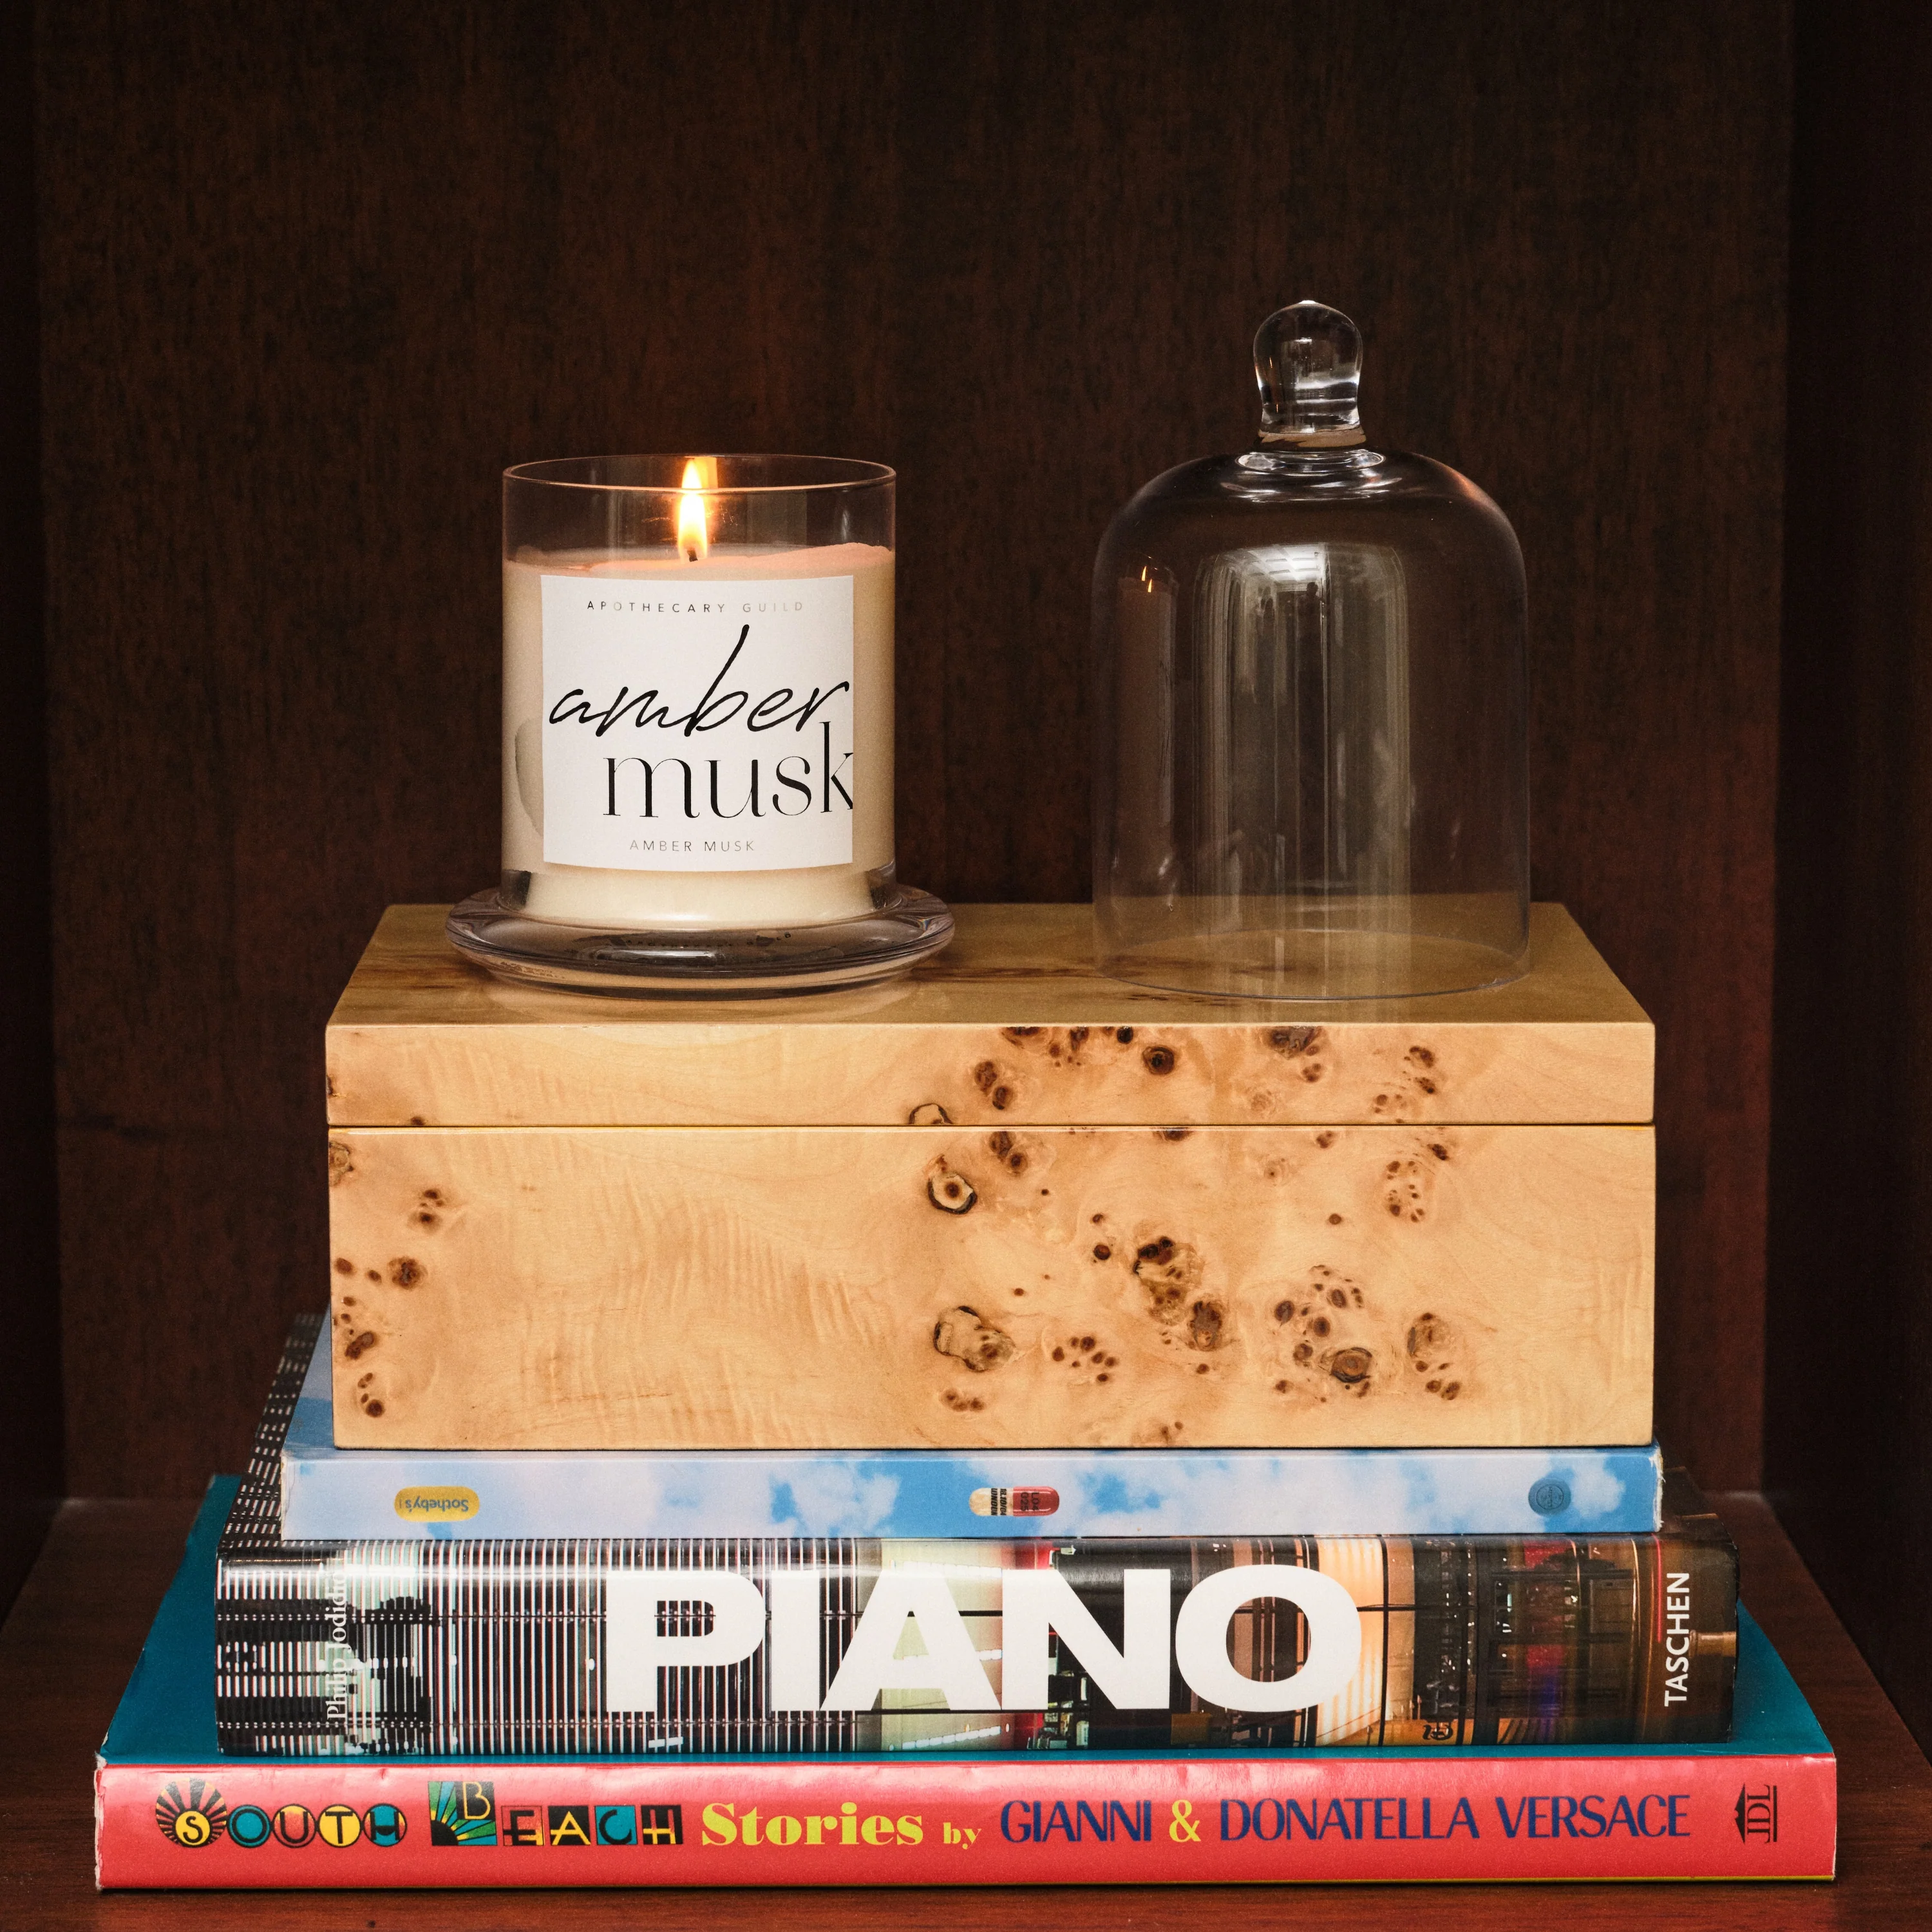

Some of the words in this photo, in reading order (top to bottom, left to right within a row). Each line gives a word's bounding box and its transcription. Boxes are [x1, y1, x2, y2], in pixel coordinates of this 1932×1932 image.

[587, 600, 725, 614] APOTHECARY
[742, 601, 804, 613] GUILD
[549, 624, 849, 737] amber
[603, 721, 853, 819] musk
[629, 839, 692, 852] AMBER
[704, 839, 755, 852] MUSK
[405, 1495, 469, 1513] Sotheby's
[606, 1564, 1361, 1712] PIANO
[1665, 1572, 1690, 1707] TASCHEN
[327, 1658, 352, 1720] Philip
[175, 1803, 407, 1848] SOUTH
[461, 1781, 680, 1846] BEACH
[702, 1802, 923, 1846] Stories
[943, 1822, 982, 1850] by
[1000, 1800, 1152, 1843] GIANNI
[1169, 1799, 1202, 1842] &
[1220, 1797, 1480, 1841] DONATELLA
[1495, 1794, 1691, 1839] VERSACE
